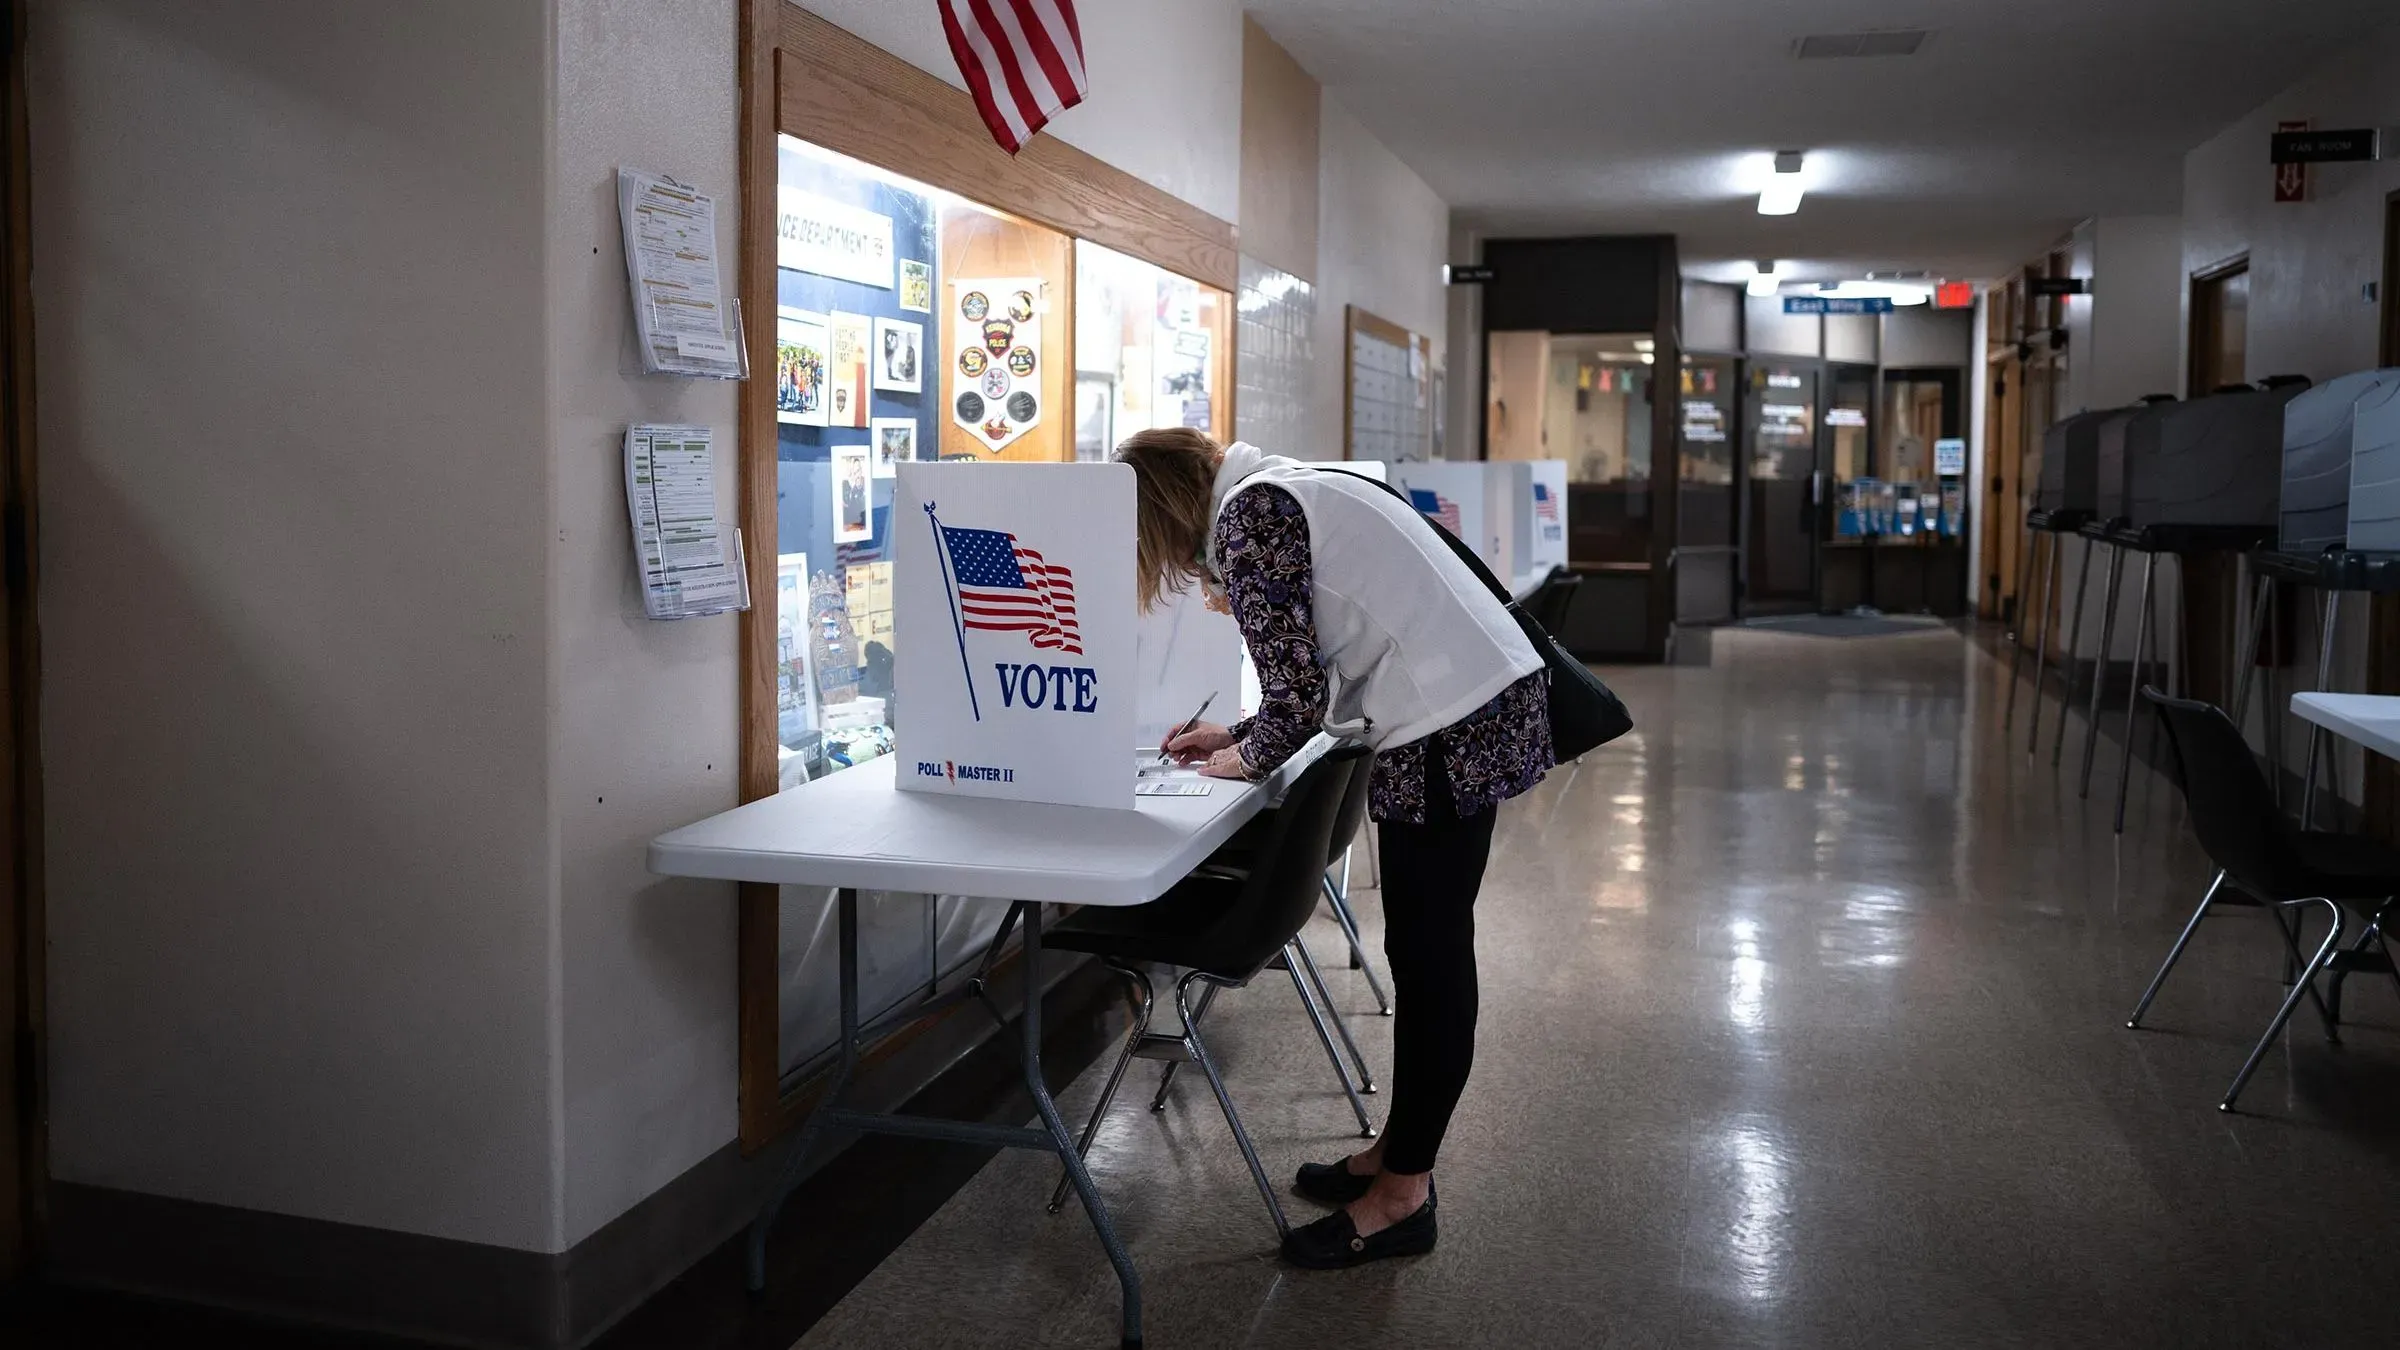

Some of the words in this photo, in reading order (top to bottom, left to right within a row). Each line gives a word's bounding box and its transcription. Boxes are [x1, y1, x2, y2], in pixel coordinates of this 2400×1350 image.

[799, 218, 868, 257] DEPARTMENT
[1791, 299, 1824, 312] East
[1827, 299, 1863, 314] Wing
[995, 663, 1097, 713] VOTE
[918, 762, 943, 777] POLL
[958, 765, 1000, 782] MASTER
[1003, 769, 1014, 783] II
